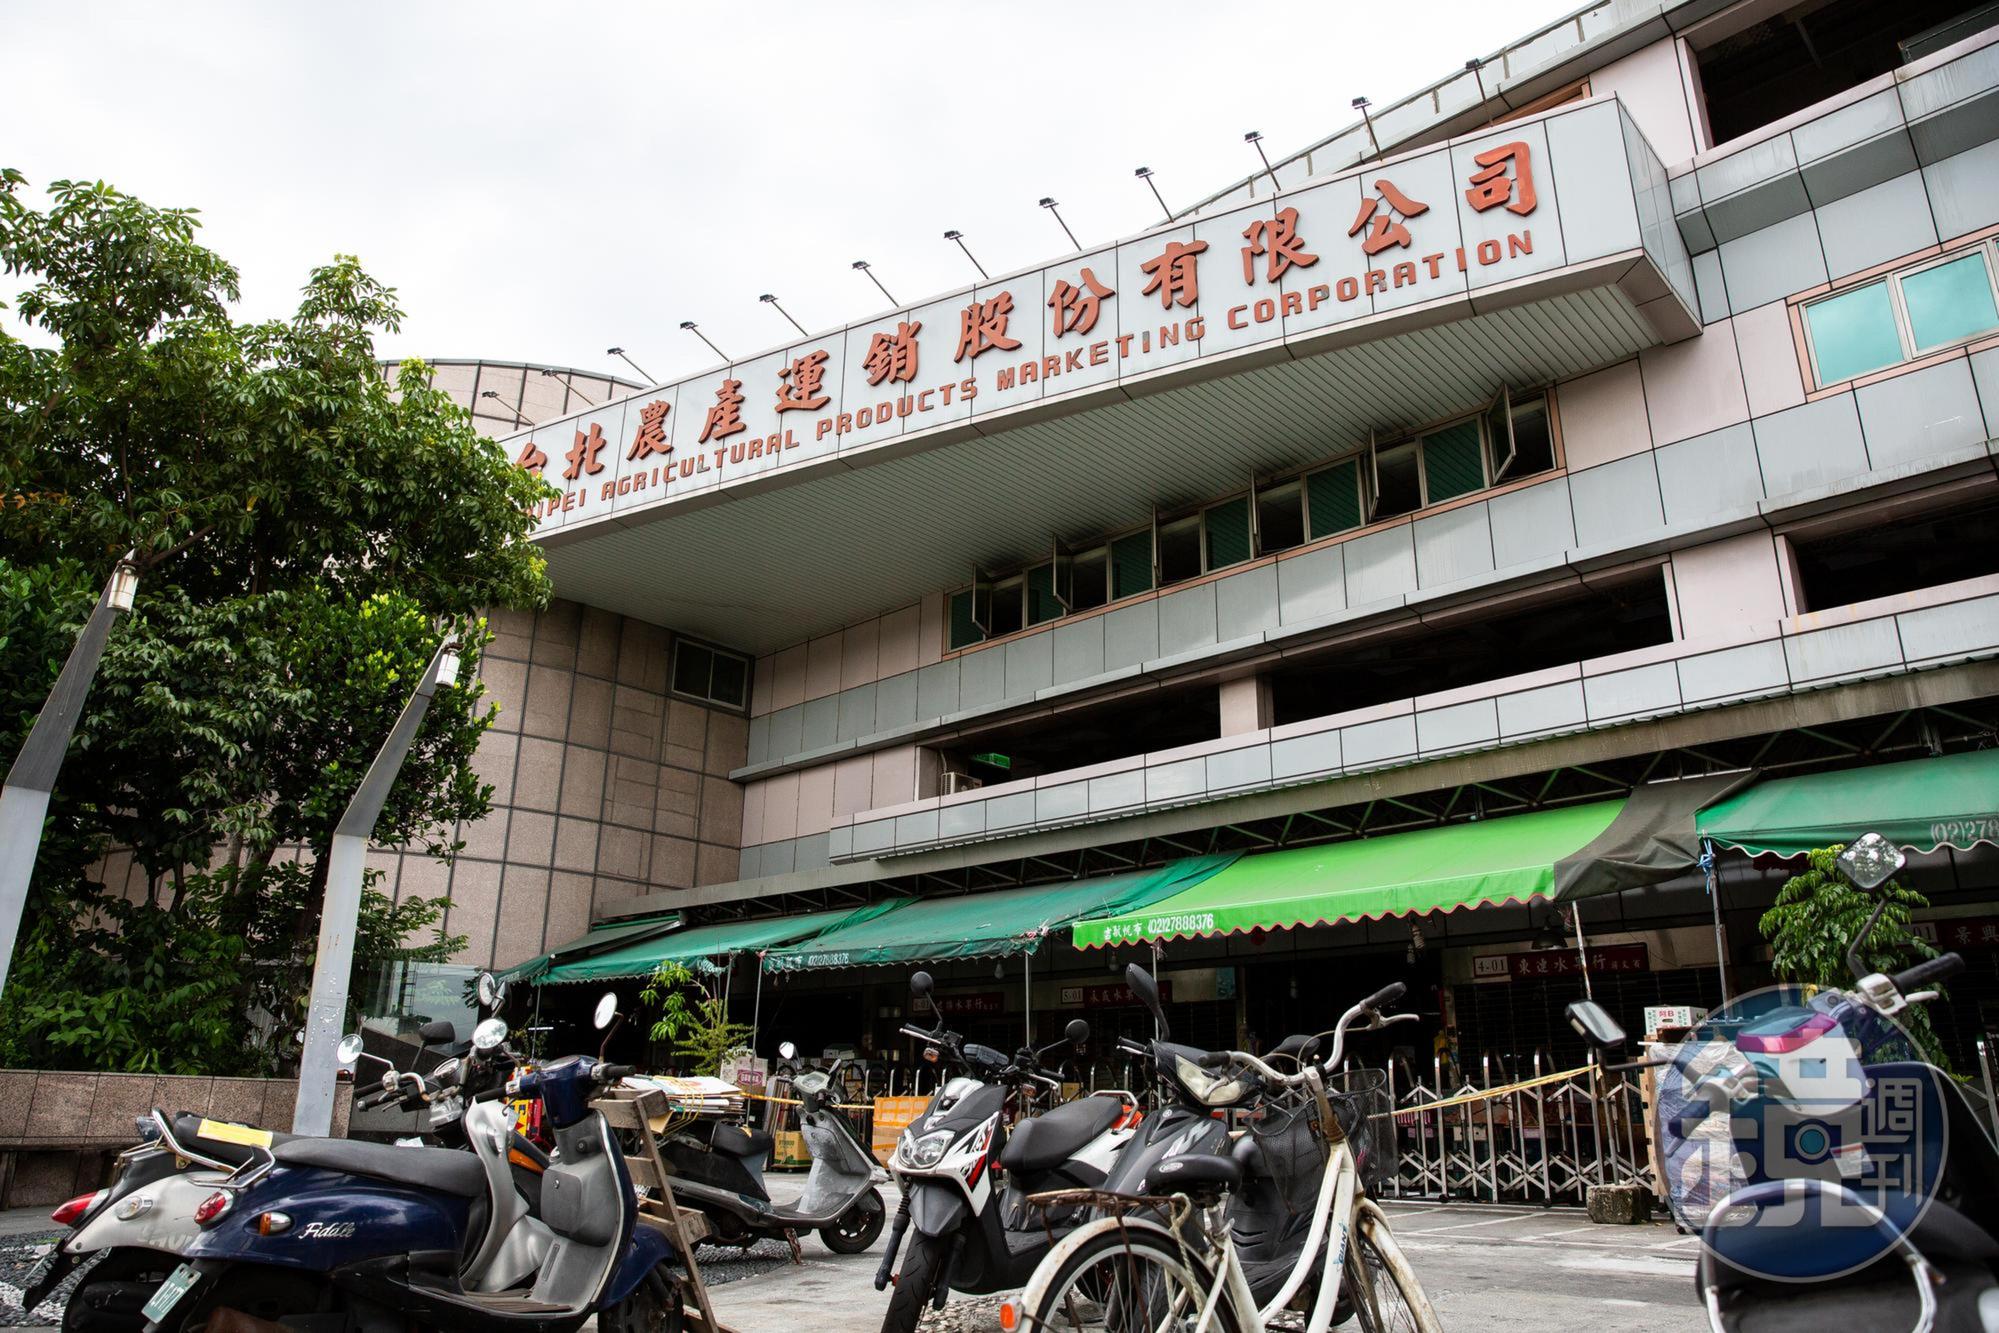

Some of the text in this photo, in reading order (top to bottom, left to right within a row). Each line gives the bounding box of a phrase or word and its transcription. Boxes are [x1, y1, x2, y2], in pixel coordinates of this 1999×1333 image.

[601, 428, 800, 501] AGRICULTURAL
[816, 377, 977, 441] PRODUCTS
[996, 316, 1205, 392] MARKETING
[1228, 230, 1534, 330] CORPORATION
[298, 1221, 356, 1240] Fiddle
